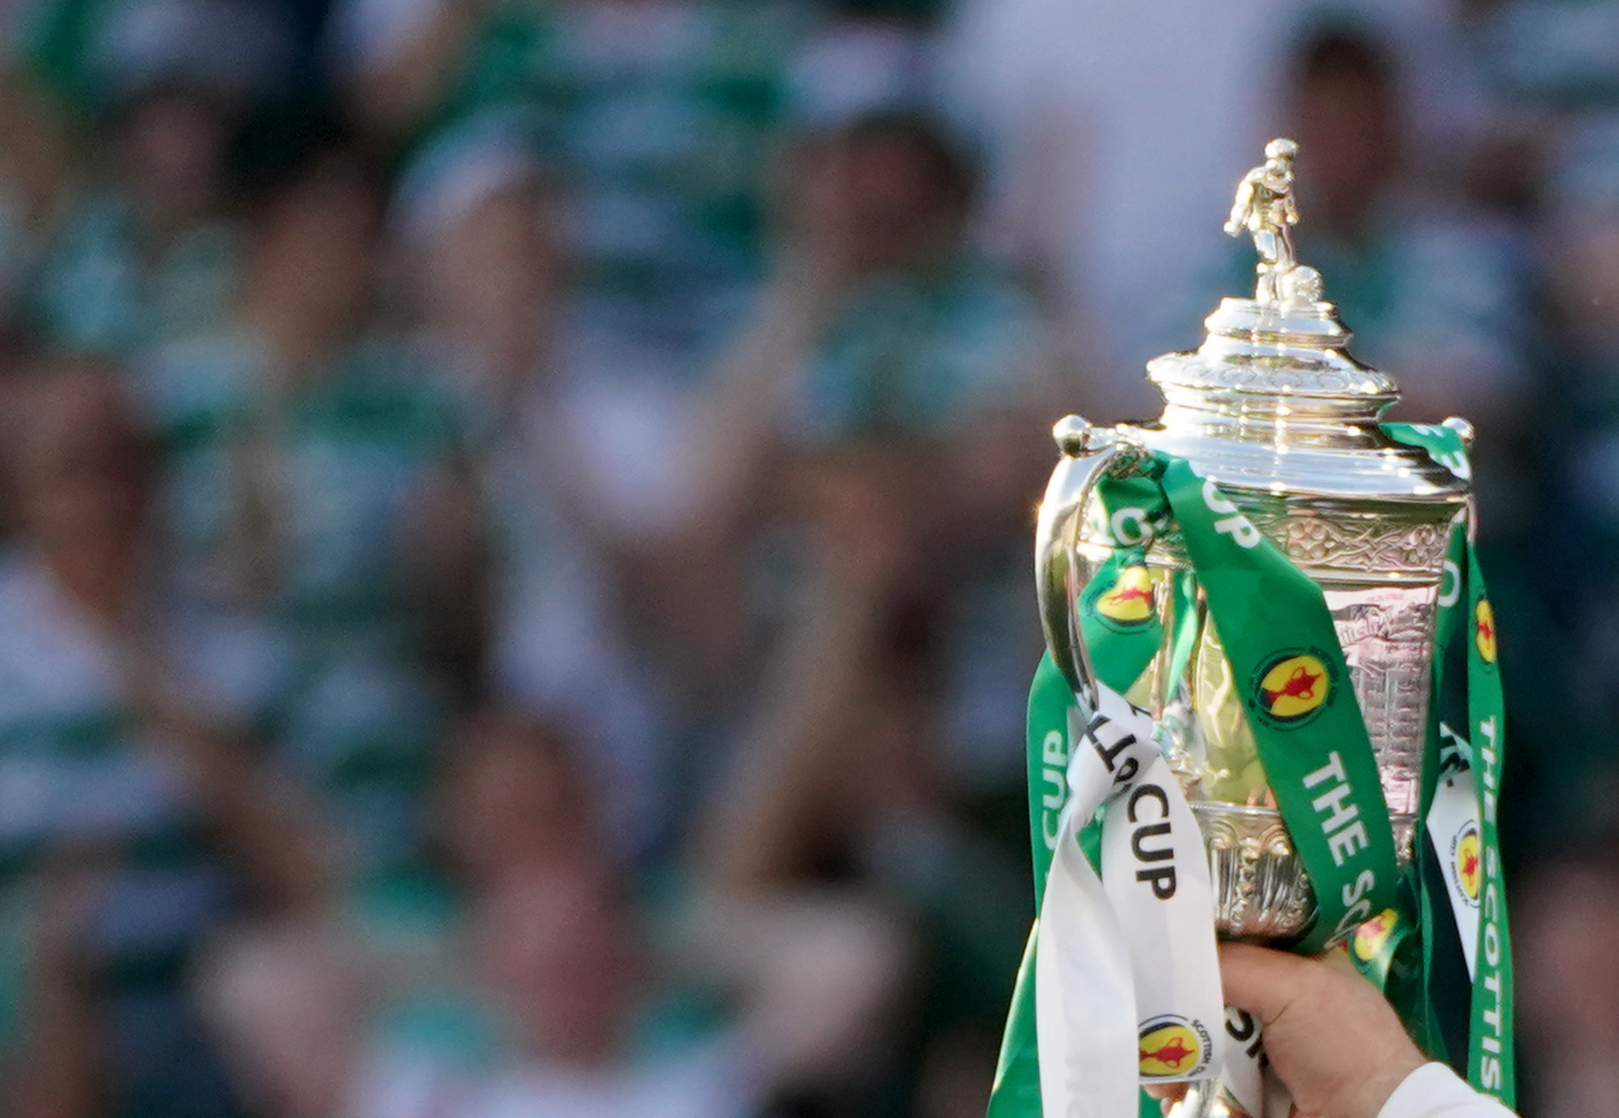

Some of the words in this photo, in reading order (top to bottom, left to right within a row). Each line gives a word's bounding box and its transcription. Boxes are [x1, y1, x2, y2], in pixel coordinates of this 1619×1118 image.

[1043, 730, 1068, 851] CUP
[1127, 783, 1177, 900] CUP
[1302, 750, 1369, 867] THE
[1480, 846, 1501, 1090] SCOTTIS
